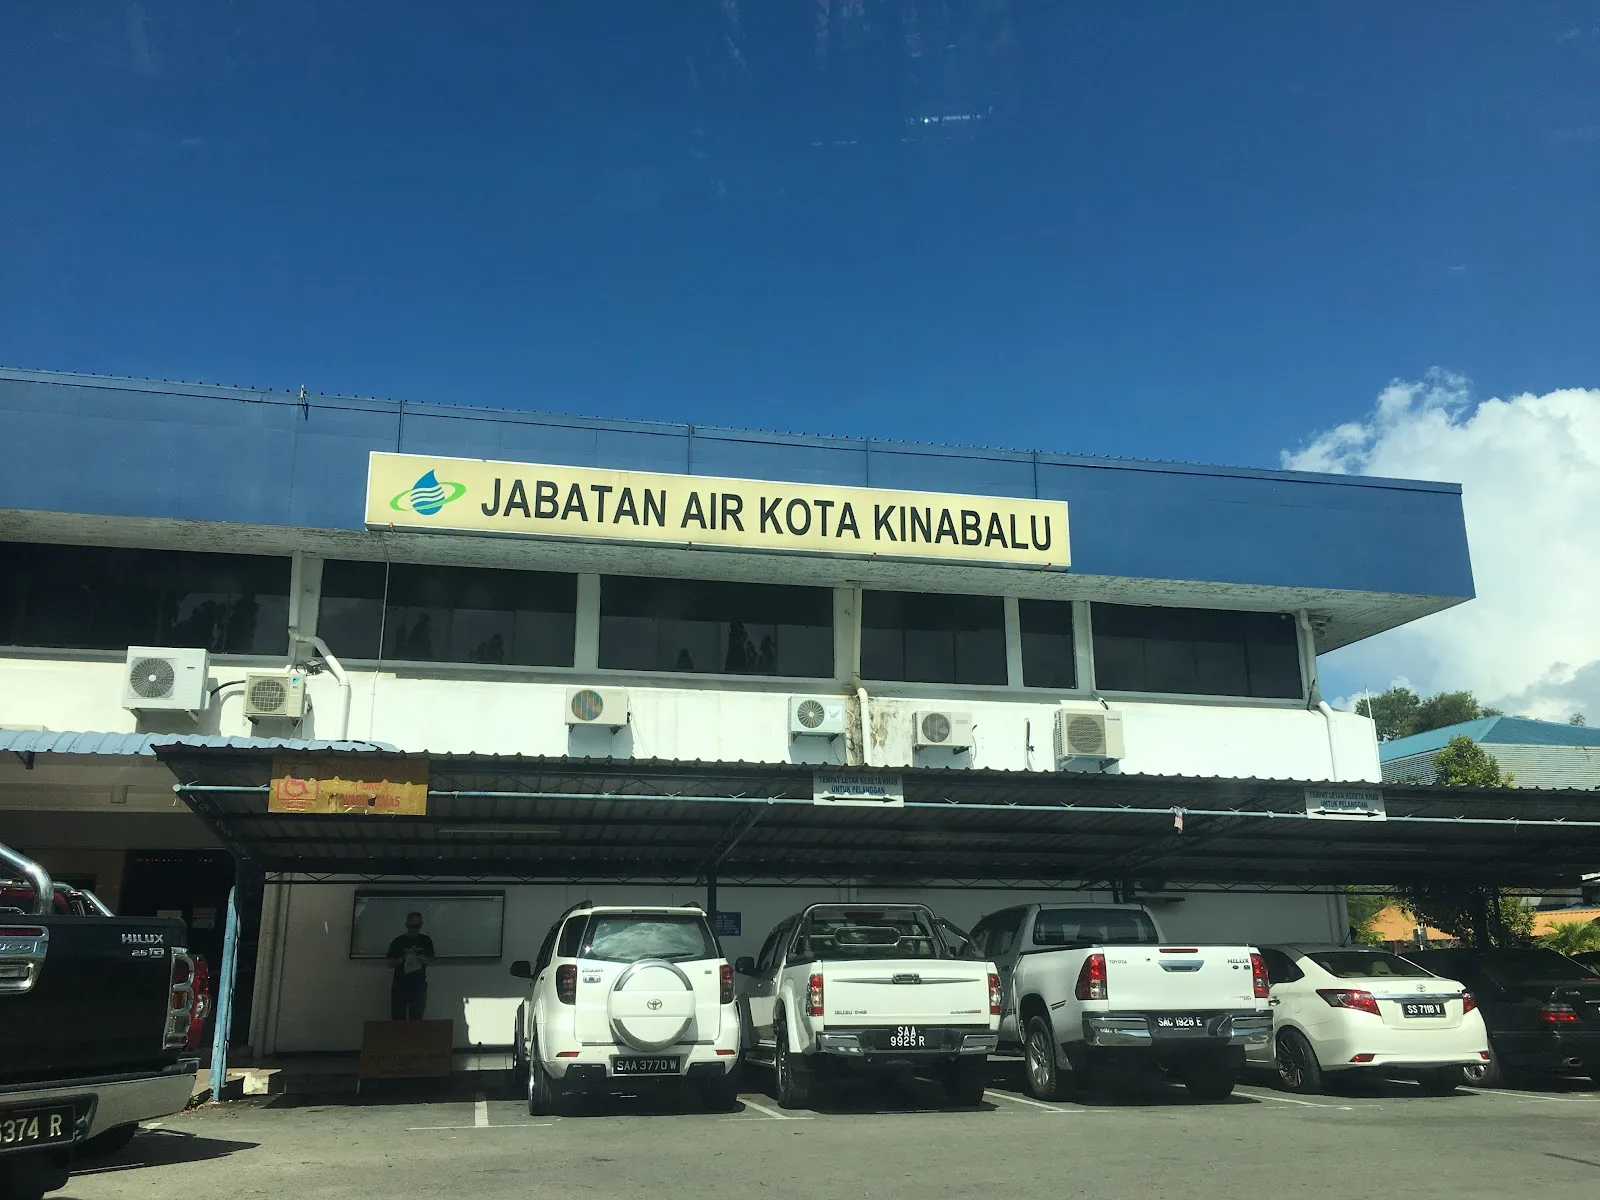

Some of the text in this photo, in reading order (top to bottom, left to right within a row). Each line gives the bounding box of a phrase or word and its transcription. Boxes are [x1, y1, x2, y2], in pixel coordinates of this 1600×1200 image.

[481, 477, 1052, 551] JABATAN AIR KOTA KINABALU
[831, 785, 885, 794] UNTUK PELANGGAN
[1320, 800, 1368, 809] UNTUK PELANGGAN
[121, 933, 164, 944] HILUX
[1407, 1004, 1418, 1014] SS
[1419, 1004, 1434, 1014] 7118
[1157, 1016, 1203, 1027] SAC 1928 E
[897, 1025, 917, 1037] SAA
[890, 1035, 925, 1047] 9925 R
[616, 1059, 677, 1071] SAA 3770 W
[0, 1113, 63, 1143] 374 R
